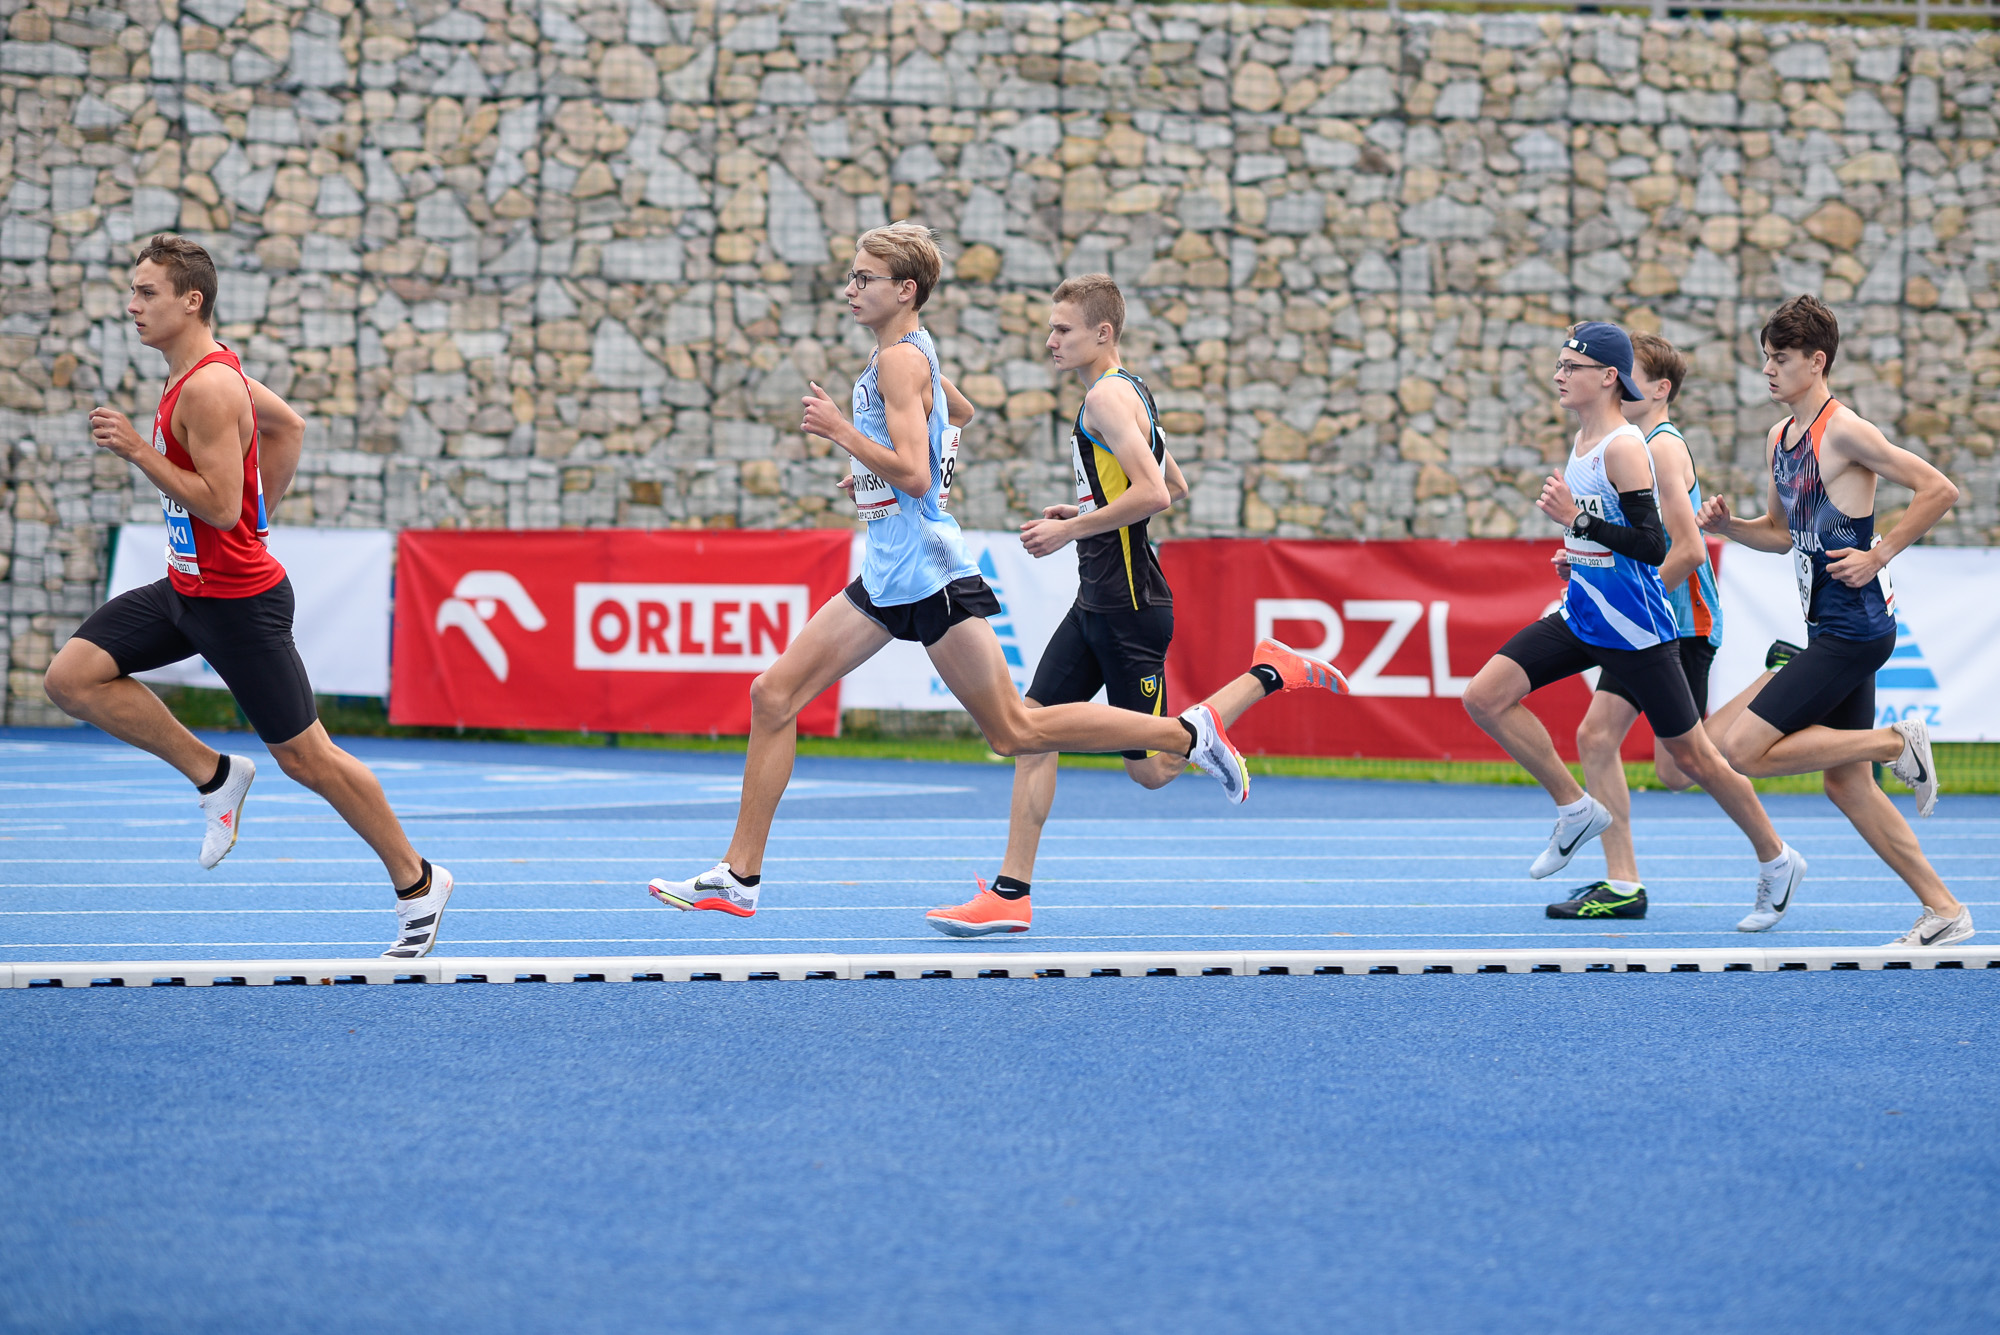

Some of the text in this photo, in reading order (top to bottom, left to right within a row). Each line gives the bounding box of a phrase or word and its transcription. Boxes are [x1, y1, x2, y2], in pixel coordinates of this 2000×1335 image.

[872, 508, 889, 519] 2021
[1588, 558, 1603, 566] 2021
[590, 599, 790, 655] ORLEN
[1254, 598, 1603, 698] PZL
